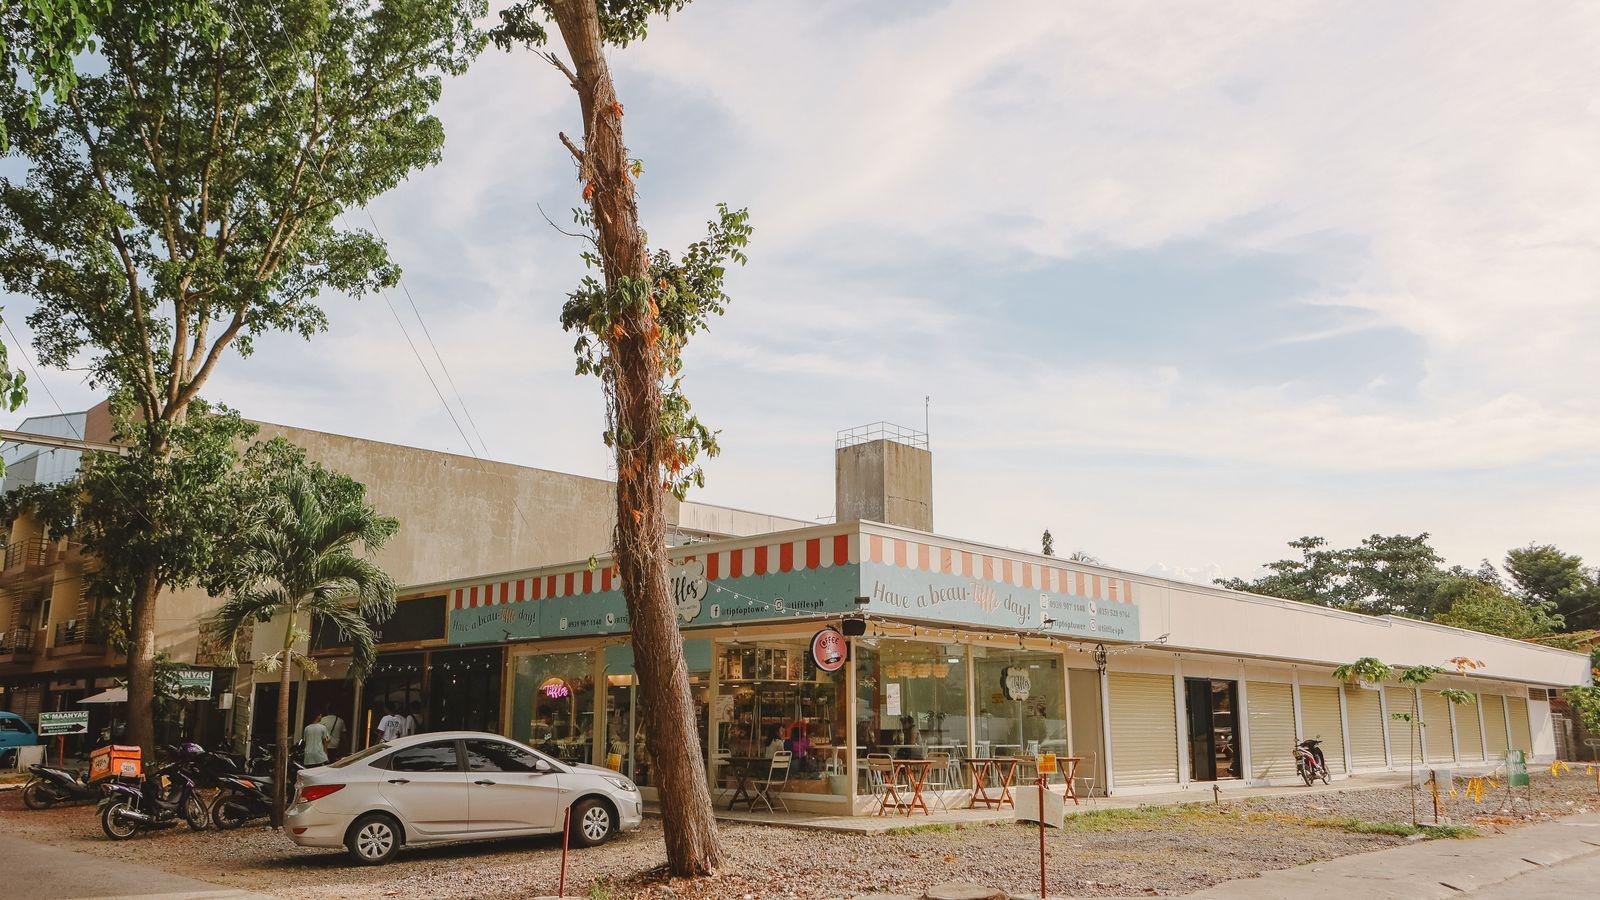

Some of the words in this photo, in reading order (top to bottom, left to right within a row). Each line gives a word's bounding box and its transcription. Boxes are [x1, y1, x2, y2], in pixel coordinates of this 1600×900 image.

[873, 580, 911, 609] Have
[917, 593, 927, 608] a
[1003, 593, 1031, 625] day!
[179, 671, 210, 679] ANYAG
[52, 712, 88, 720] MAANYAG
